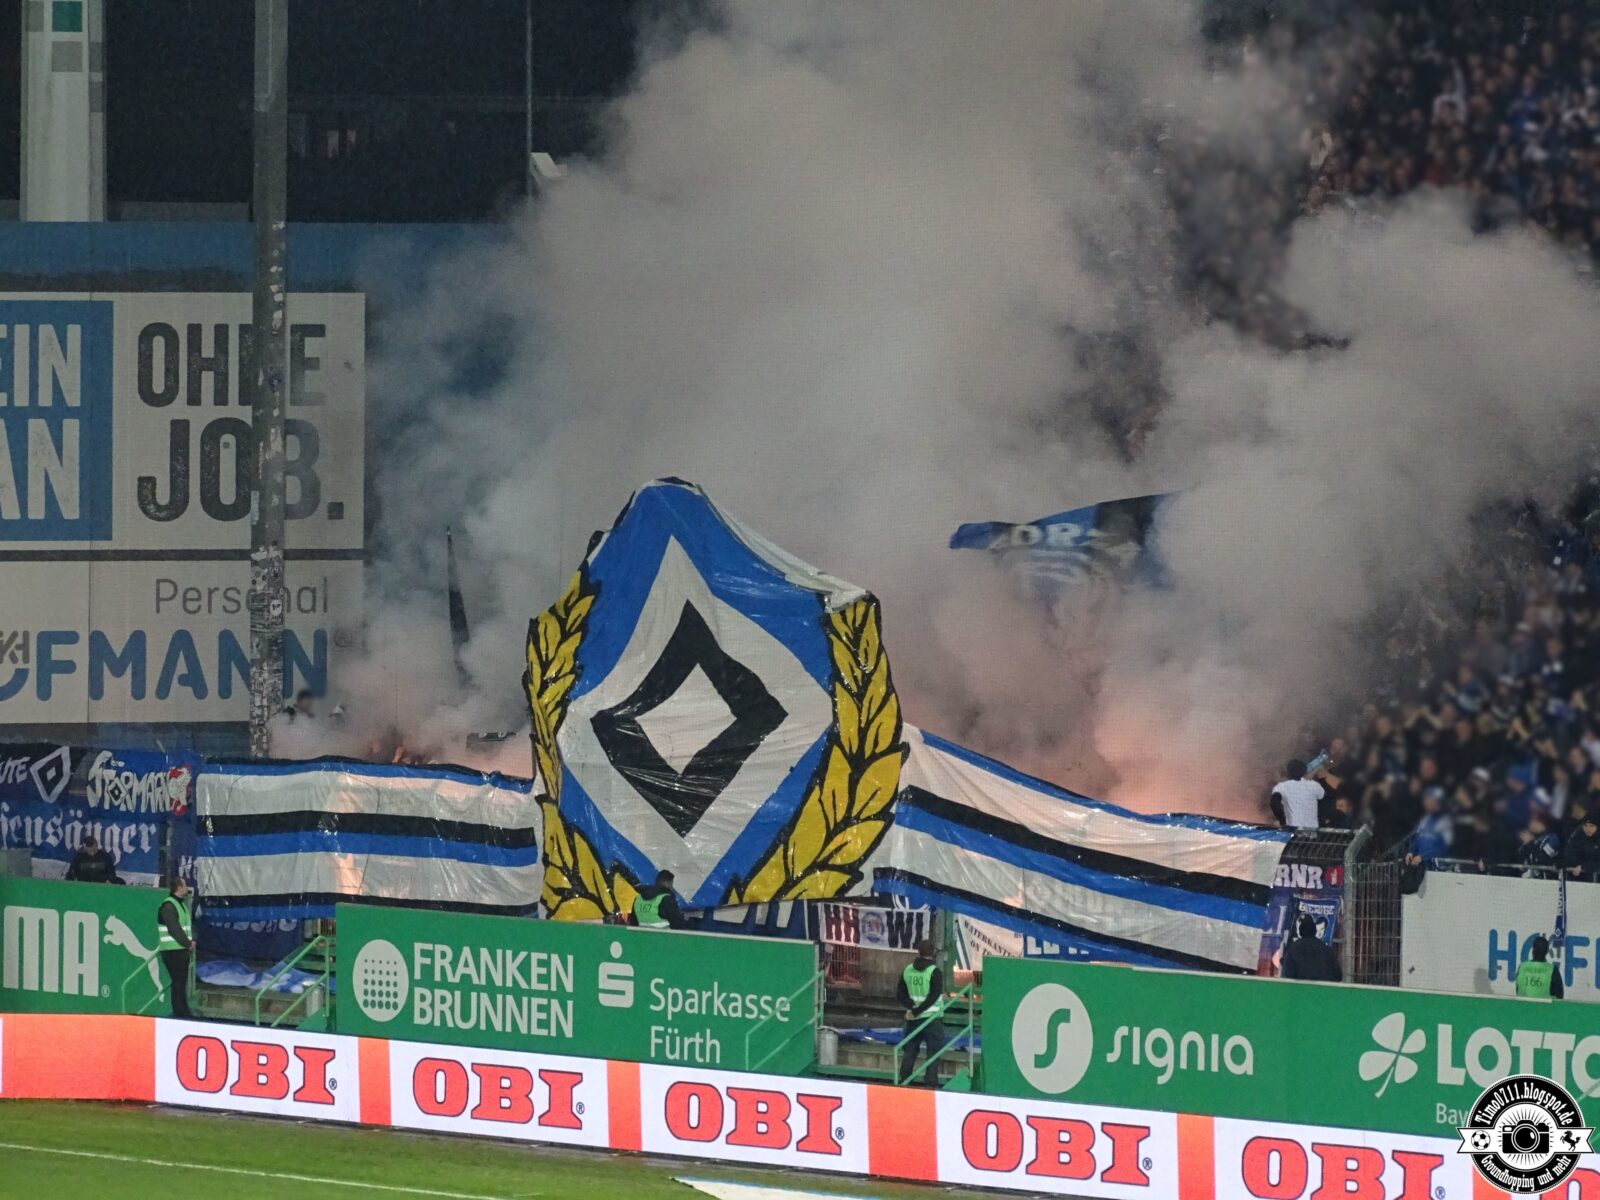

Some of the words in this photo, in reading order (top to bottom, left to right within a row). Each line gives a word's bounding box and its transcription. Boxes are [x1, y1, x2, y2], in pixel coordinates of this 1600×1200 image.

[0, 323, 81, 407] IN
[138, 417, 345, 522] JOB.
[155, 576, 328, 614] Persal
[3, 905, 99, 997] MA
[413, 942, 574, 993] FRANKEN
[413, 988, 574, 1038] BRUNNEN
[649, 978, 791, 1023] Sparkasse
[650, 1026, 721, 1064] Fürth
[1106, 1025, 1254, 1085] signia
